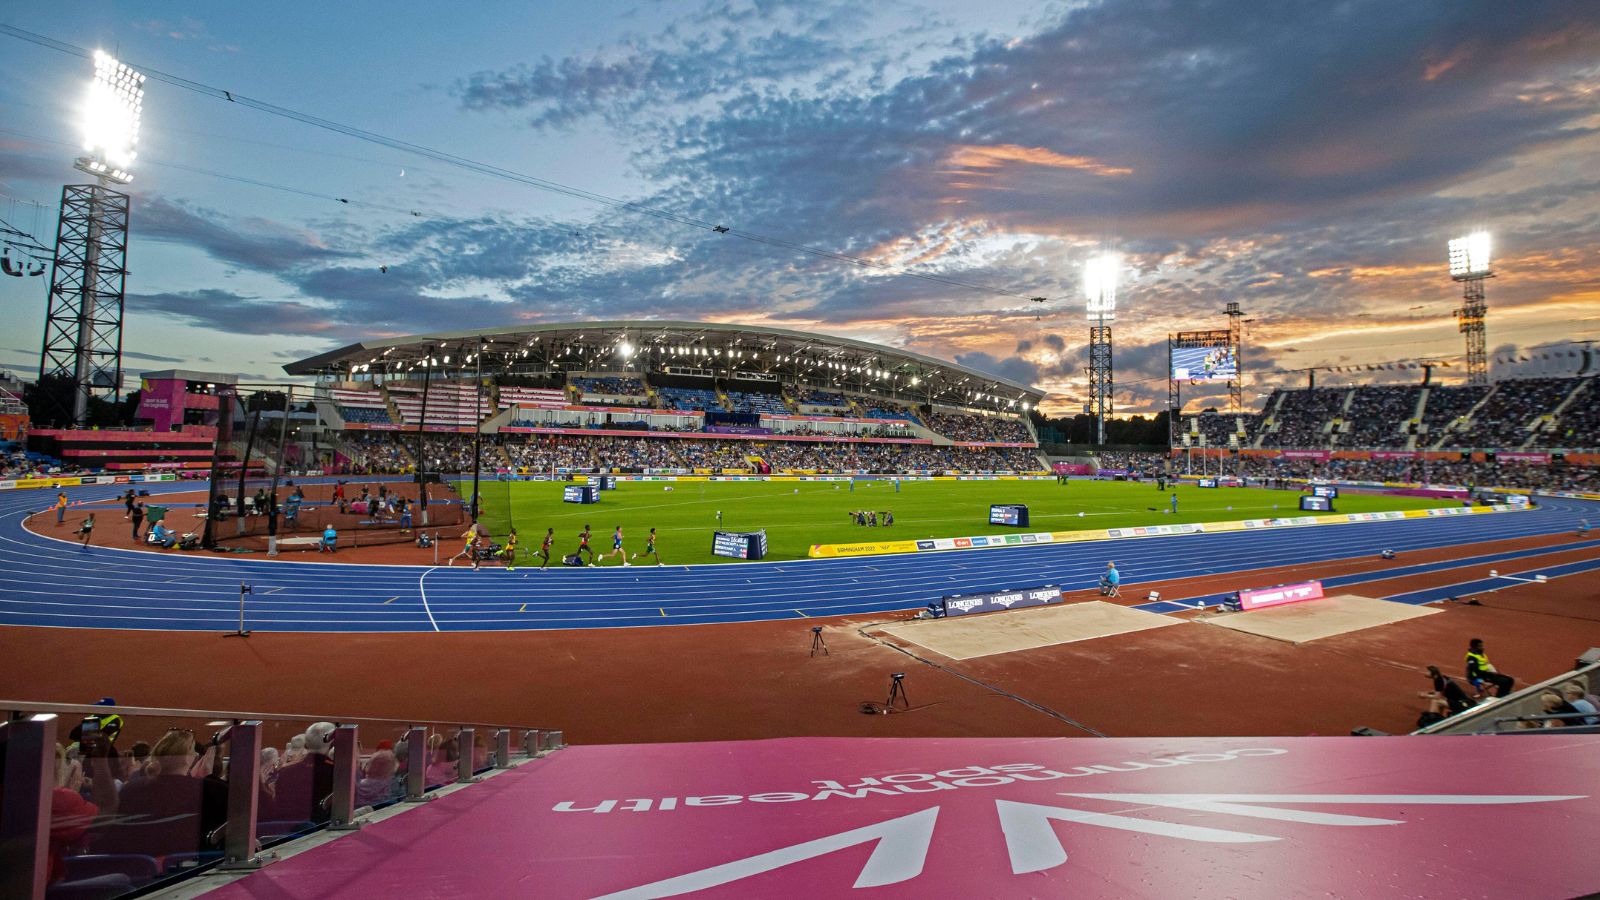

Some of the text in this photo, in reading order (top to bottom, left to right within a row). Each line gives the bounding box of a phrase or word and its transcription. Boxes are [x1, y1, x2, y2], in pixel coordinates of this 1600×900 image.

[948, 589, 1060, 609] LONGINES LONGINES LONGINES
[552, 748, 1289, 813] commonwealth
[811, 763, 1046, 790] sport
